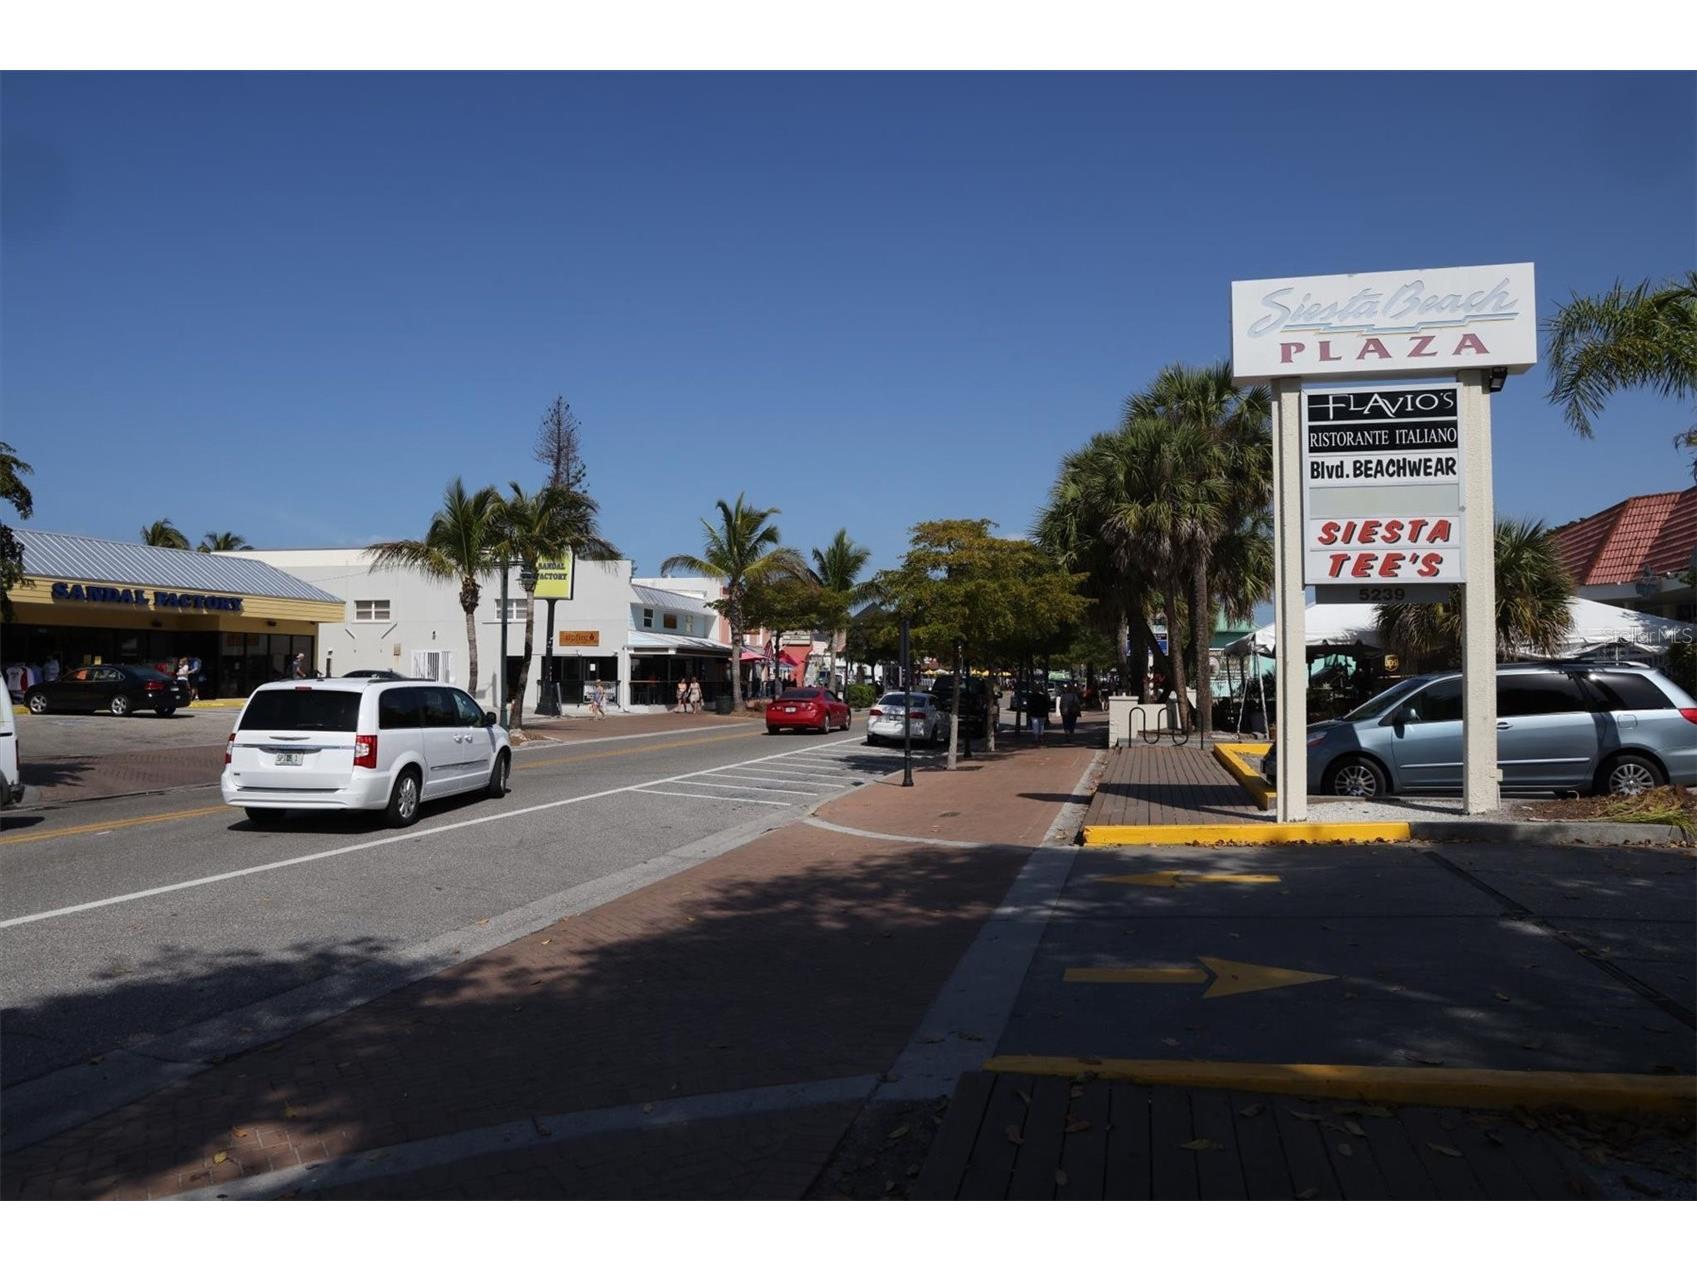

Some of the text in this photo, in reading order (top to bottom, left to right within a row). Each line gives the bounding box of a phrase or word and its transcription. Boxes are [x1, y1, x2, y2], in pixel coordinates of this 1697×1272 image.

[1247, 277, 1519, 337] Siesta Beach
[1280, 333, 1490, 364] PLAZA
[1309, 391, 1455, 421] FLAVIO'S
[1309, 427, 1457, 448] RISTORANTE ITALIANO
[1310, 457, 1457, 479] Blvd. BEACHWEAR
[1318, 519, 1452, 545] SIESTA
[1328, 552, 1443, 578] TEE'S
[51, 582, 244, 612] SANDAL FACTORY
[1359, 588, 1406, 601] 5239
